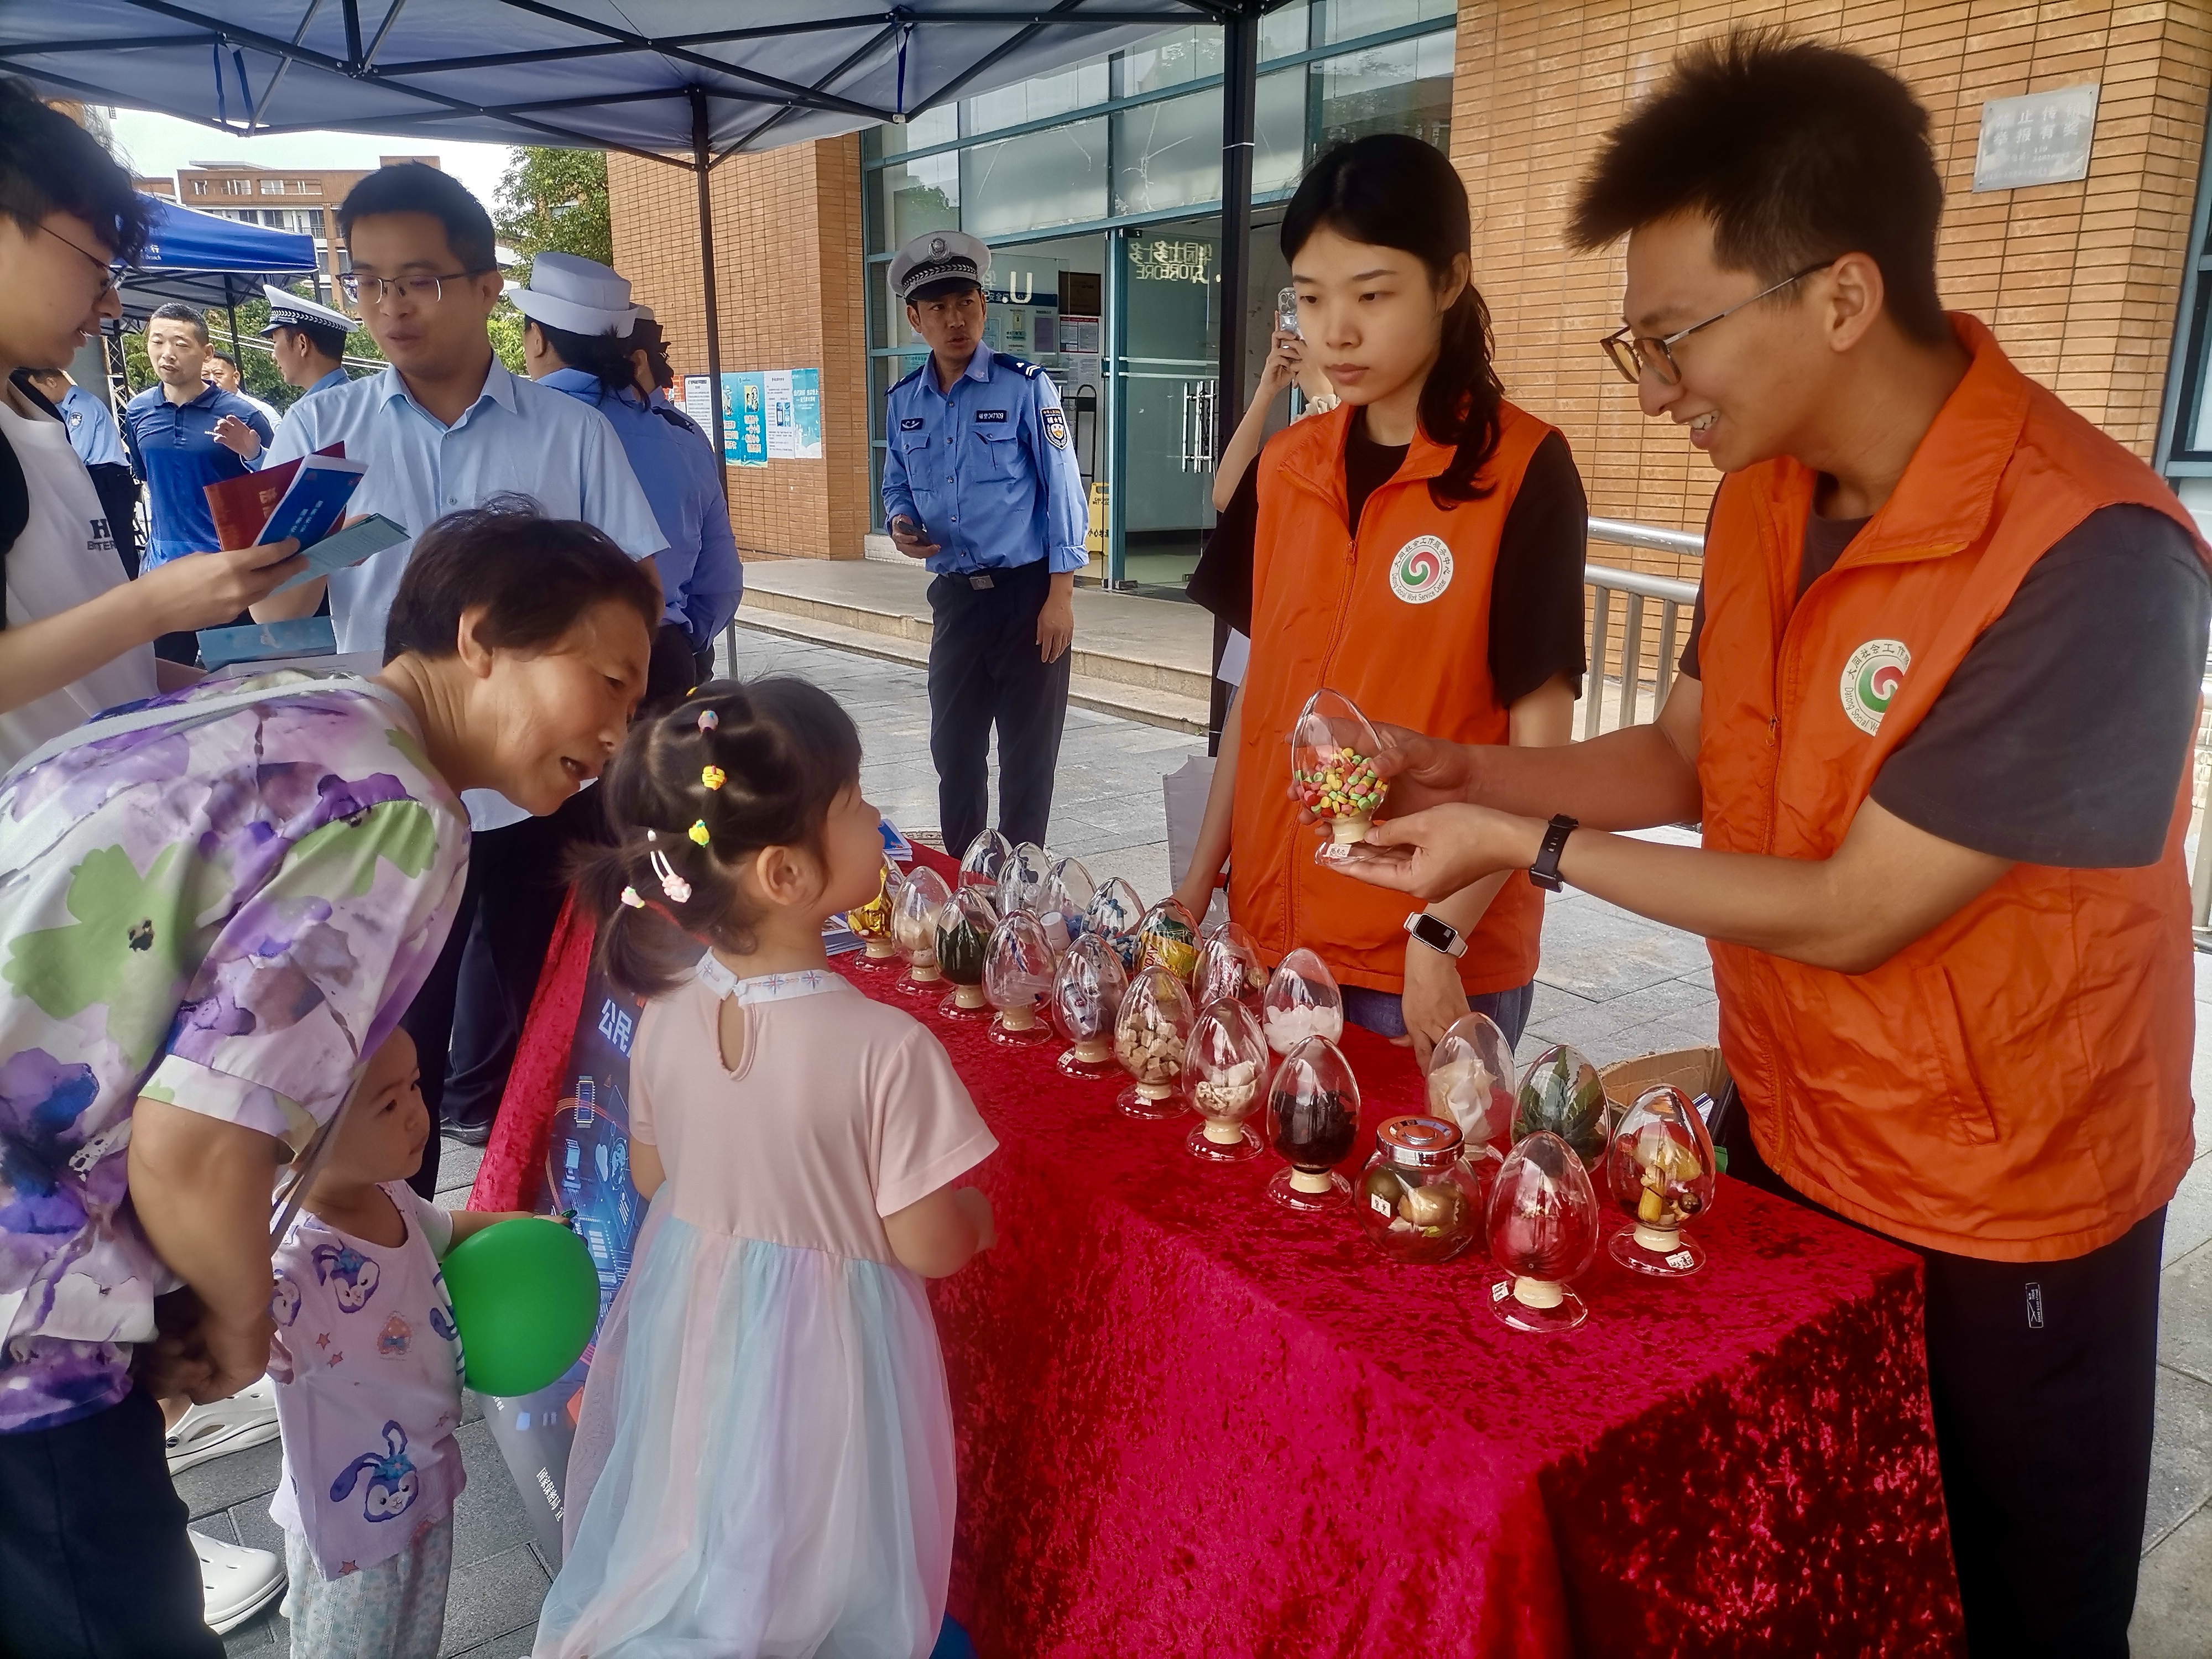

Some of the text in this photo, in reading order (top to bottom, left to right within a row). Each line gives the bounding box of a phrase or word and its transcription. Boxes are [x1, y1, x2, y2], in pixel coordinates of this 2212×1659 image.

[1394, 538, 1451, 576] 大同社会工作服务中心
[1396, 586, 1408, 598] Social
[1418, 591, 1434, 601] Service
[1434, 579, 1447, 593] Center
[1844, 687, 1855, 711] Datong
[1851, 708, 1870, 728] Social
[598, 998, 632, 1058] 公民
[536, 1467, 561, 1511] 国家保密局
